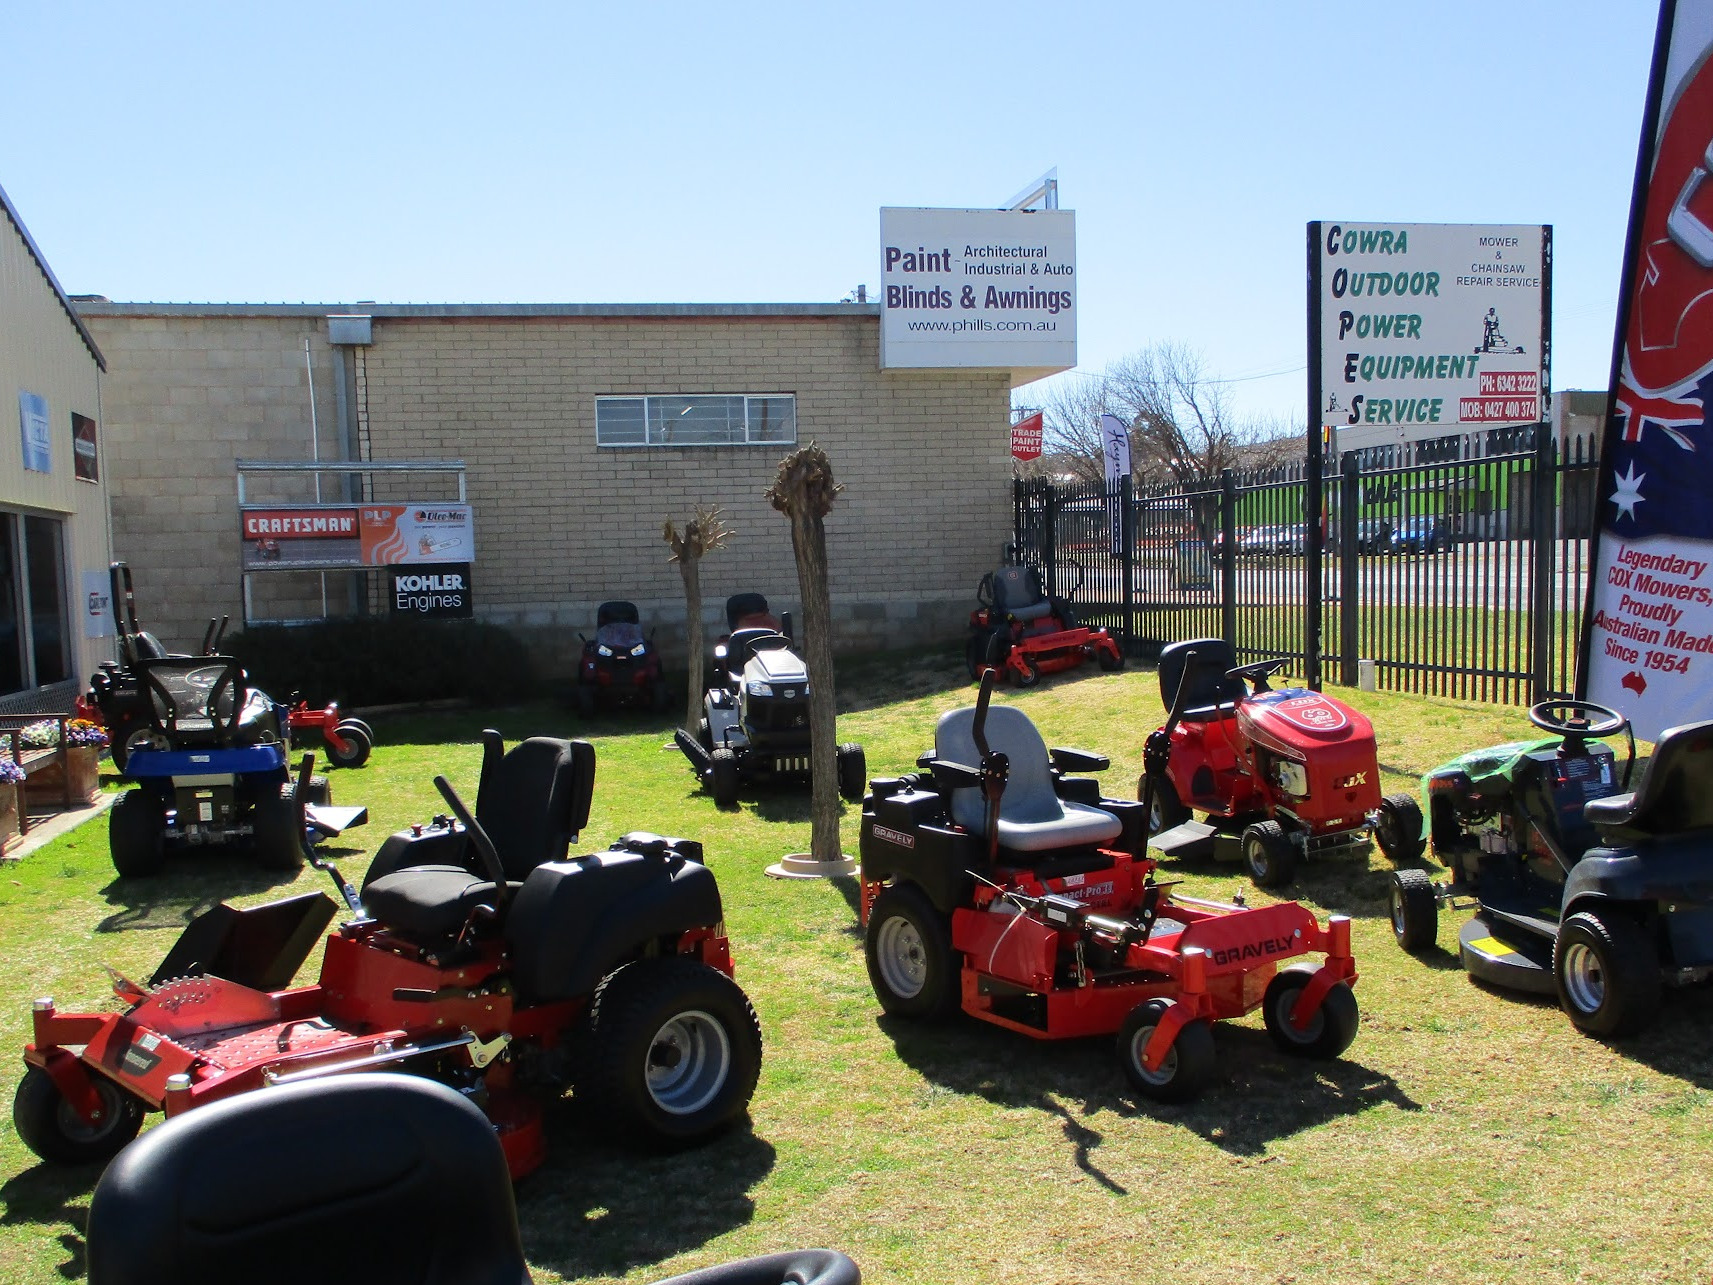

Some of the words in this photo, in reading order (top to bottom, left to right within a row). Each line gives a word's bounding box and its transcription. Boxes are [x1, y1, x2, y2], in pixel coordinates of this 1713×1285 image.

[1327, 226, 1408, 255] COWRA
[1479, 237, 1518, 247] MOWER
[886, 247, 952, 272] Paint
[964, 245, 1047, 258] Architectural
[1495, 251, 1502, 260] &
[964, 263, 1026, 275] Industrial
[1030, 263, 1039, 275] &
[1043, 263, 1074, 275] Auto
[1471, 264, 1526, 274] CHAINSAW
[1332, 268, 1440, 298] OUTDOOR
[1456, 276, 1493, 287] REPAIR
[1496, 278, 1539, 288] SERVICE
[887, 285, 952, 309] Blinds
[960, 285, 977, 309] &
[984, 286, 1072, 314] Awnings
[908, 320, 1056, 334] www.phills.com.au
[1339, 310, 1422, 340] POWER
[1344, 353, 1479, 382] EQUIPMENT
[1480, 375, 1495, 392] PH:
[1496, 375, 1516, 392] 6342
[1517, 376, 1537, 392] 3222
[1348, 394, 1443, 424] SERVICE
[1460, 402, 1482, 418] MOB:
[1484, 402, 1503, 418] 0427
[1505, 402, 1520, 418] 400
[1522, 402, 1535, 417] 374
[1013, 429, 1042, 437] TRADE
[1013, 438, 1040, 446] PAINT
[248, 518, 352, 534] CRAFTSMAN
[1617, 544, 1708, 580] Legendary
[395, 575, 466, 592] KOHLER
[1608, 566, 1632, 589] COX
[396, 594, 462, 612] Engines
[1618, 594, 1684, 628] Proudly
[1592, 610, 1660, 645] Australian
[1605, 638, 1639, 664] Since
[1644, 651, 1691, 674] 1954
[874, 827, 912, 845] GRAVELY
[1214, 936, 1294, 966] GRAVELY
